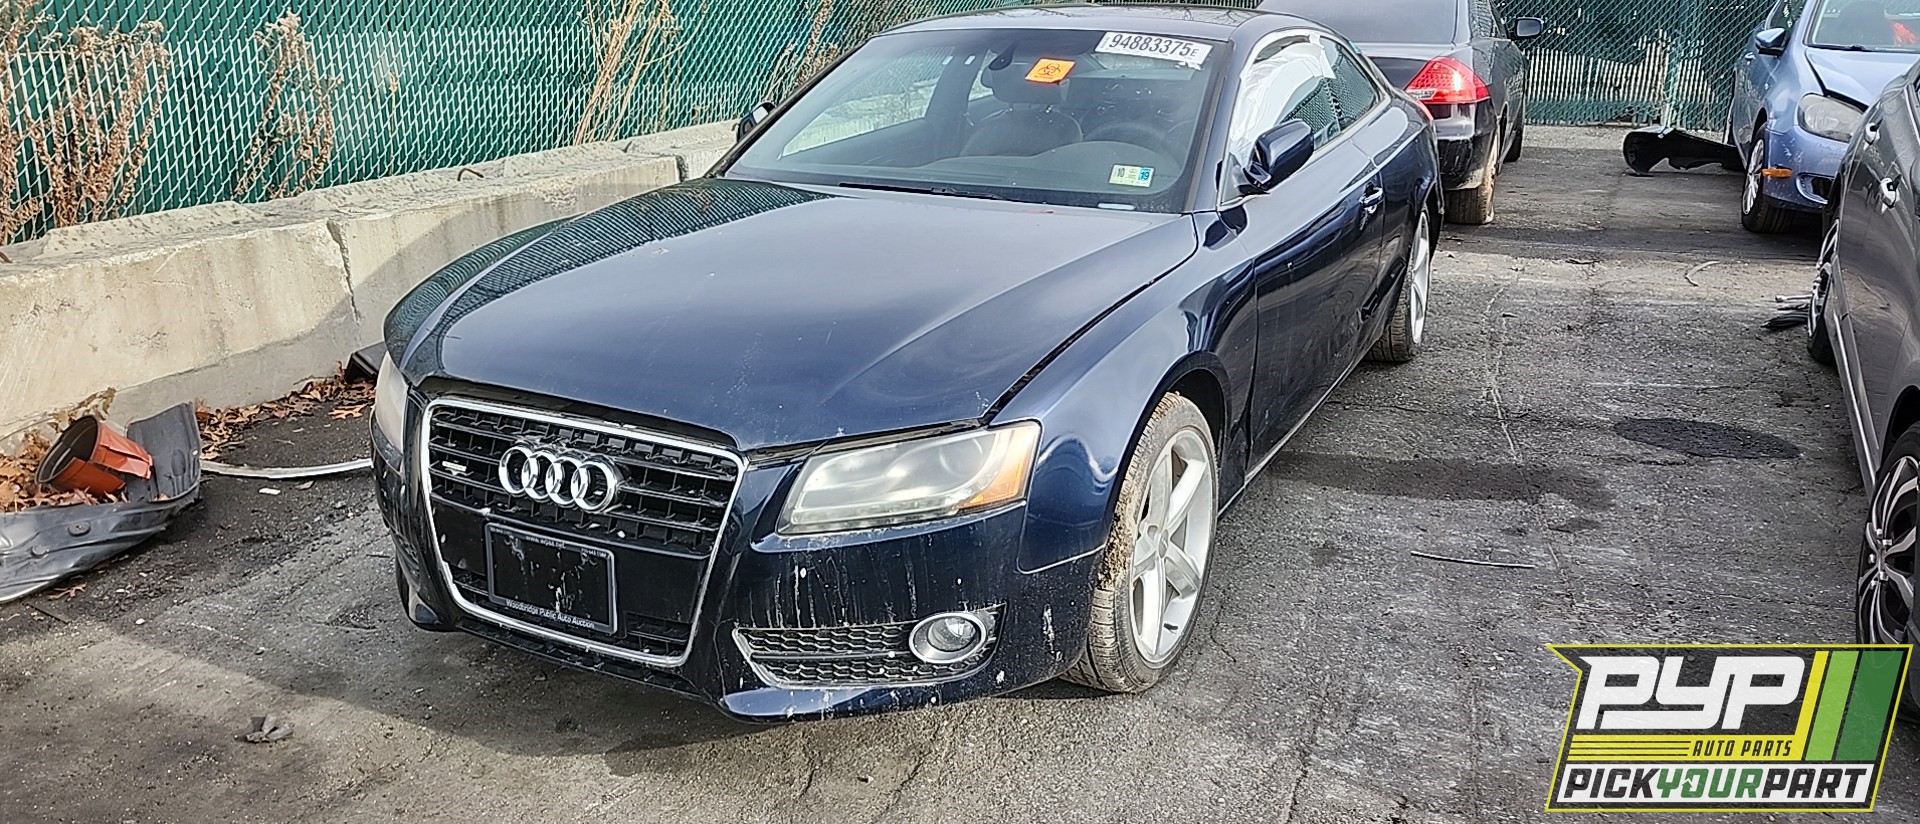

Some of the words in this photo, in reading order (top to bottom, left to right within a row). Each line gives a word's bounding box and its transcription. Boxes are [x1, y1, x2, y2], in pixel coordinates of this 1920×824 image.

[506, 598, 539, 615] Woodbridge
[539, 607, 557, 620] Public
[557, 613, 572, 623] Auto
[572, 616, 595, 629] Auction
